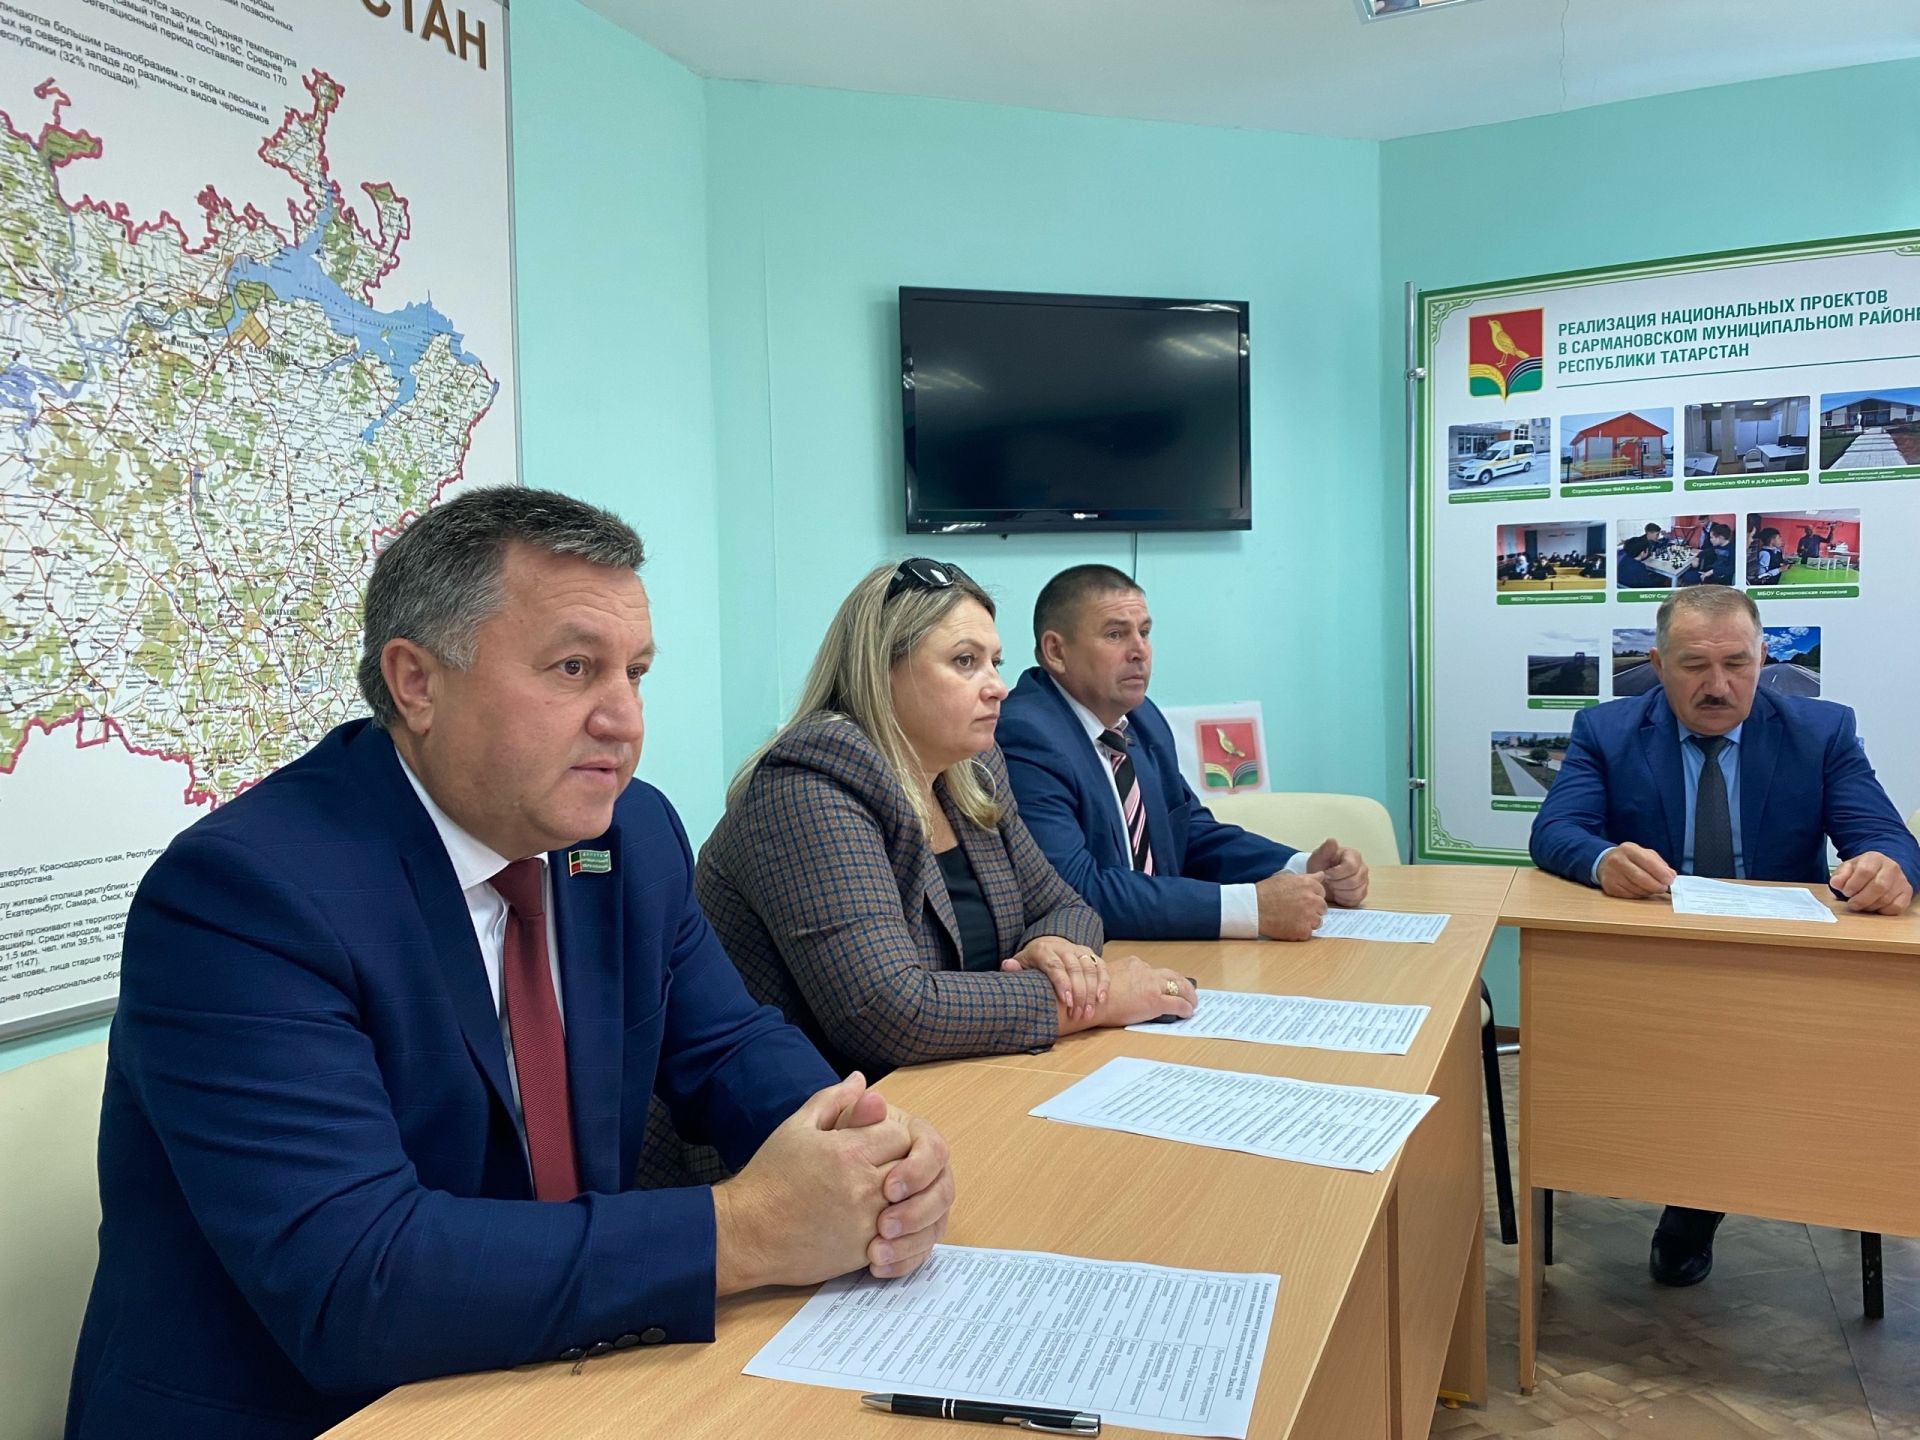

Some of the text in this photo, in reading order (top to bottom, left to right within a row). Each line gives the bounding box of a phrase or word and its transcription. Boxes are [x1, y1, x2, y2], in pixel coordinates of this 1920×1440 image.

[241, 3, 293, 32] позвоночных
[150, 10, 185, 31] теплый
[186, 26, 218, 47] месяц)
[247, 51, 283, 73] Среднее
[160, 27, 194, 48] период
[196, 42, 244, 68] составляет
[246, 63, 271, 79] около
[273, 73, 288, 86] 170
[205, 21, 243, 44] Средняя
[245, 39, 297, 68] температура
[19, 23, 32, 34] на
[35, 29, 72, 50] севере
[75, 44, 82, 54] и
[84, 48, 120, 68] западе
[122, 62, 135, 74] до
[138, 68, 188, 94] различных
[190, 88, 217, 105] видов
[219, 101, 270, 125] черноземов
[53, 20, 101, 47] большим
[104, 42, 178, 78] разнообразием
[186, 75, 196, 84] от
[199, 80, 226, 97] серых
[228, 91, 259, 111] лесных
[261, 105, 267, 113] и
[1558, 289, 1888, 337] РЕАЛИЗАЦИЯ НАЦИОНАЛЬНЫХ ПРОЕКТОВ
[1558, 342, 1567, 355] В
[1572, 328, 1697, 354] САРМАНОВСКОМ
[1702, 313, 1853, 341] МУНИЦИПАЛЬНОМ
[1558, 343, 1749, 374] РЕСПУБЛИКИ ТАТАРСТАН
[0, 866, 38, 879] етербург,
[40, 857, 103, 871] Краснодарского
[13, 894, 48, 907] жителей
[50, 890, 82, 901] столица
[84, 883, 128, 897] республики
[0, 929, 24, 941] остей
[26, 921, 71, 936] проживают
[73, 919, 83, 927] на
[39, 933, 65, 944] Среди
[61, 941, 76, 949] или
[50, 962, 70, 972] лица
[72, 956, 101, 968] старше
[23, 975, 101, 999] профессиональное
